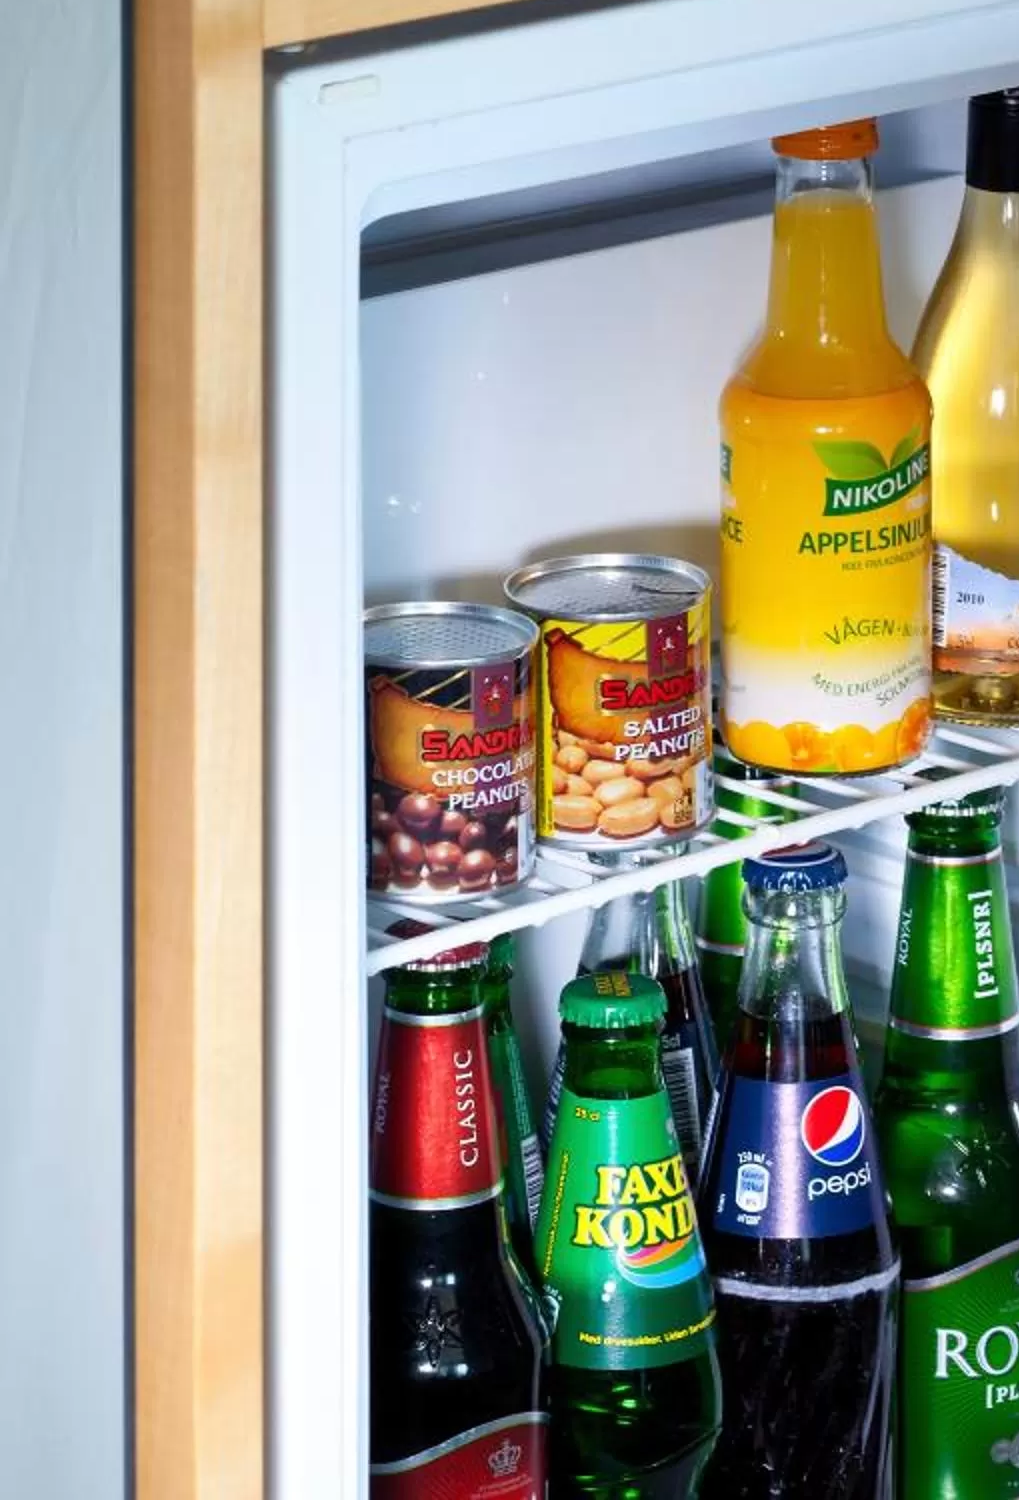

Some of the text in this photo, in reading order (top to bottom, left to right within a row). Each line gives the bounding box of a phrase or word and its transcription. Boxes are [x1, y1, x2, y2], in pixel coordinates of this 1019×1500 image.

[955, 591, 985, 605] 2010
[623, 706, 700, 737] SALTED
[614, 726, 705, 761] PEANUTS
[447, 777, 528, 812] PEANUTS
[898, 908, 913, 966] ROYAL
[453, 1049, 479, 1167] CLASSIC
[807, 1161, 873, 1201] pepsi
[573, 1196, 694, 1248] KOND
